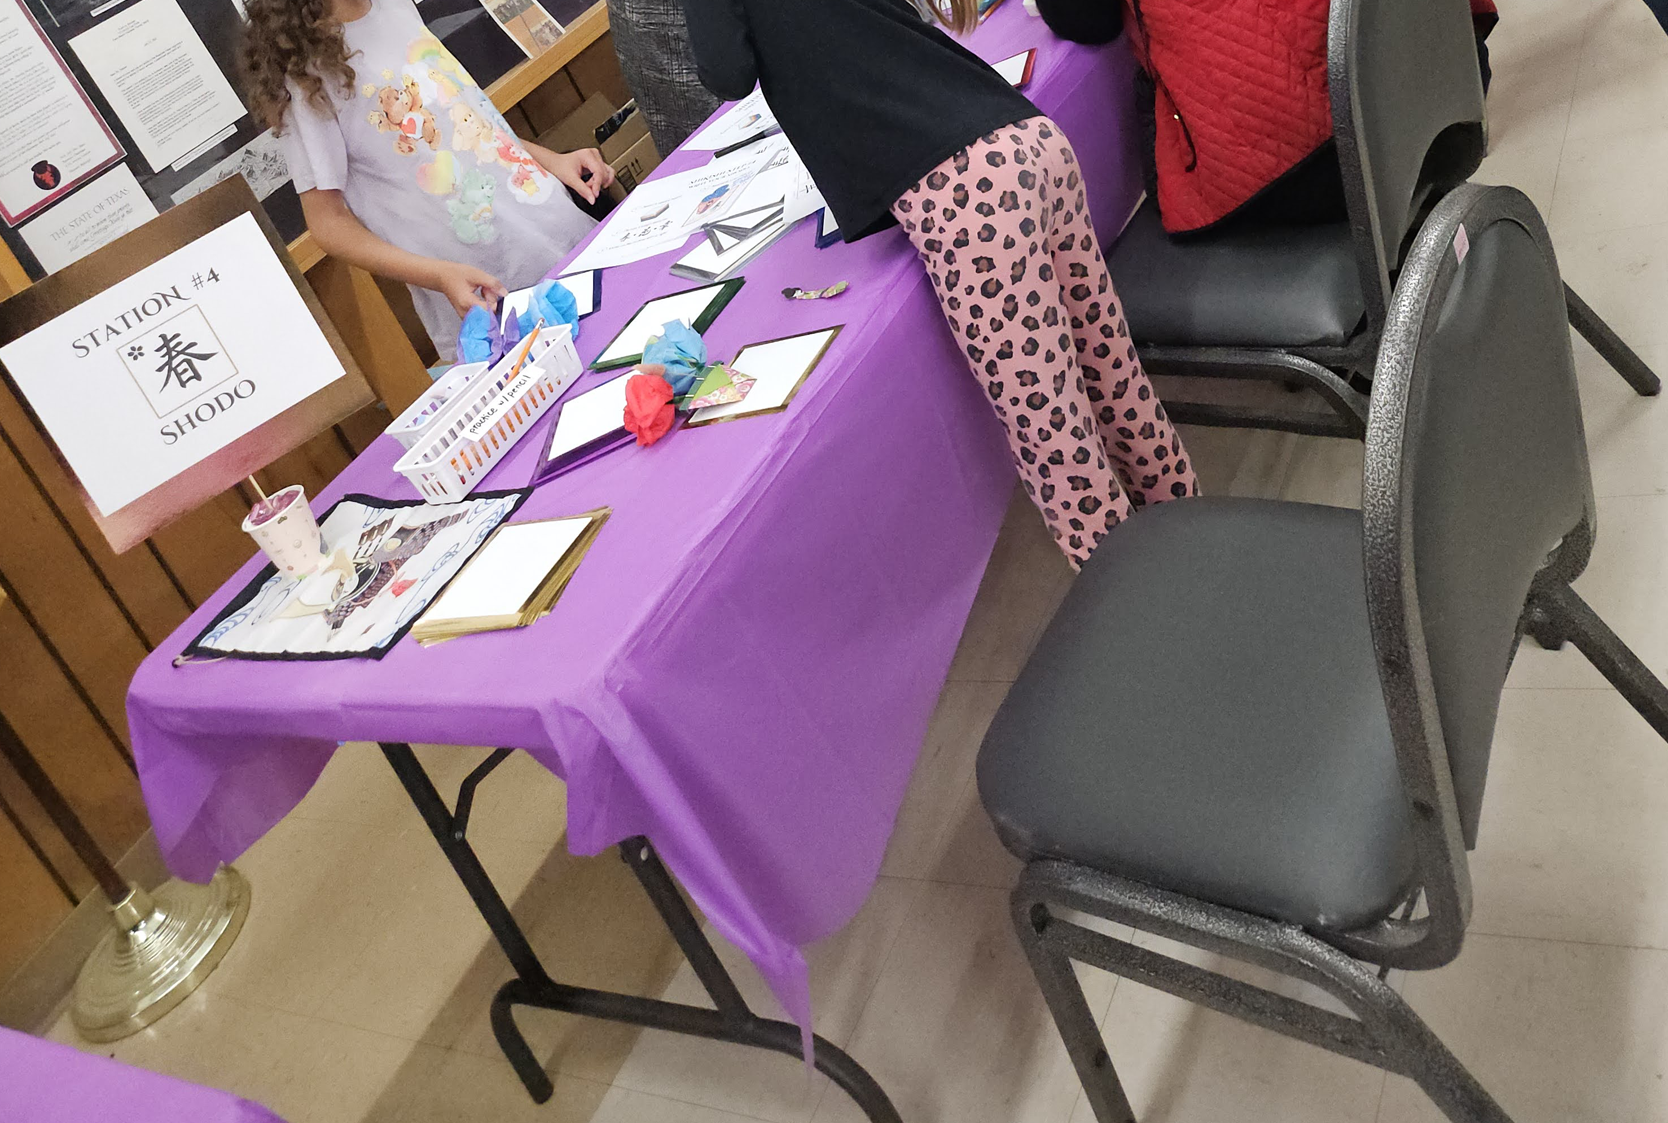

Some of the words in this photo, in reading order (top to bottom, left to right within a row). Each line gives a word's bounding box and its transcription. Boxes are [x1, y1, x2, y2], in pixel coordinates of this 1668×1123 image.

[49, 226, 69, 242] THE
[67, 211, 93, 230] STATE
[92, 201, 106, 215] OF
[104, 187, 130, 207] TEXAS
[71, 284, 192, 359] STATION
[191, 266, 221, 291] #4
[153, 332, 220, 395] 春
[159, 378, 257, 446] SHODO
[469, 407, 499, 435] practice
